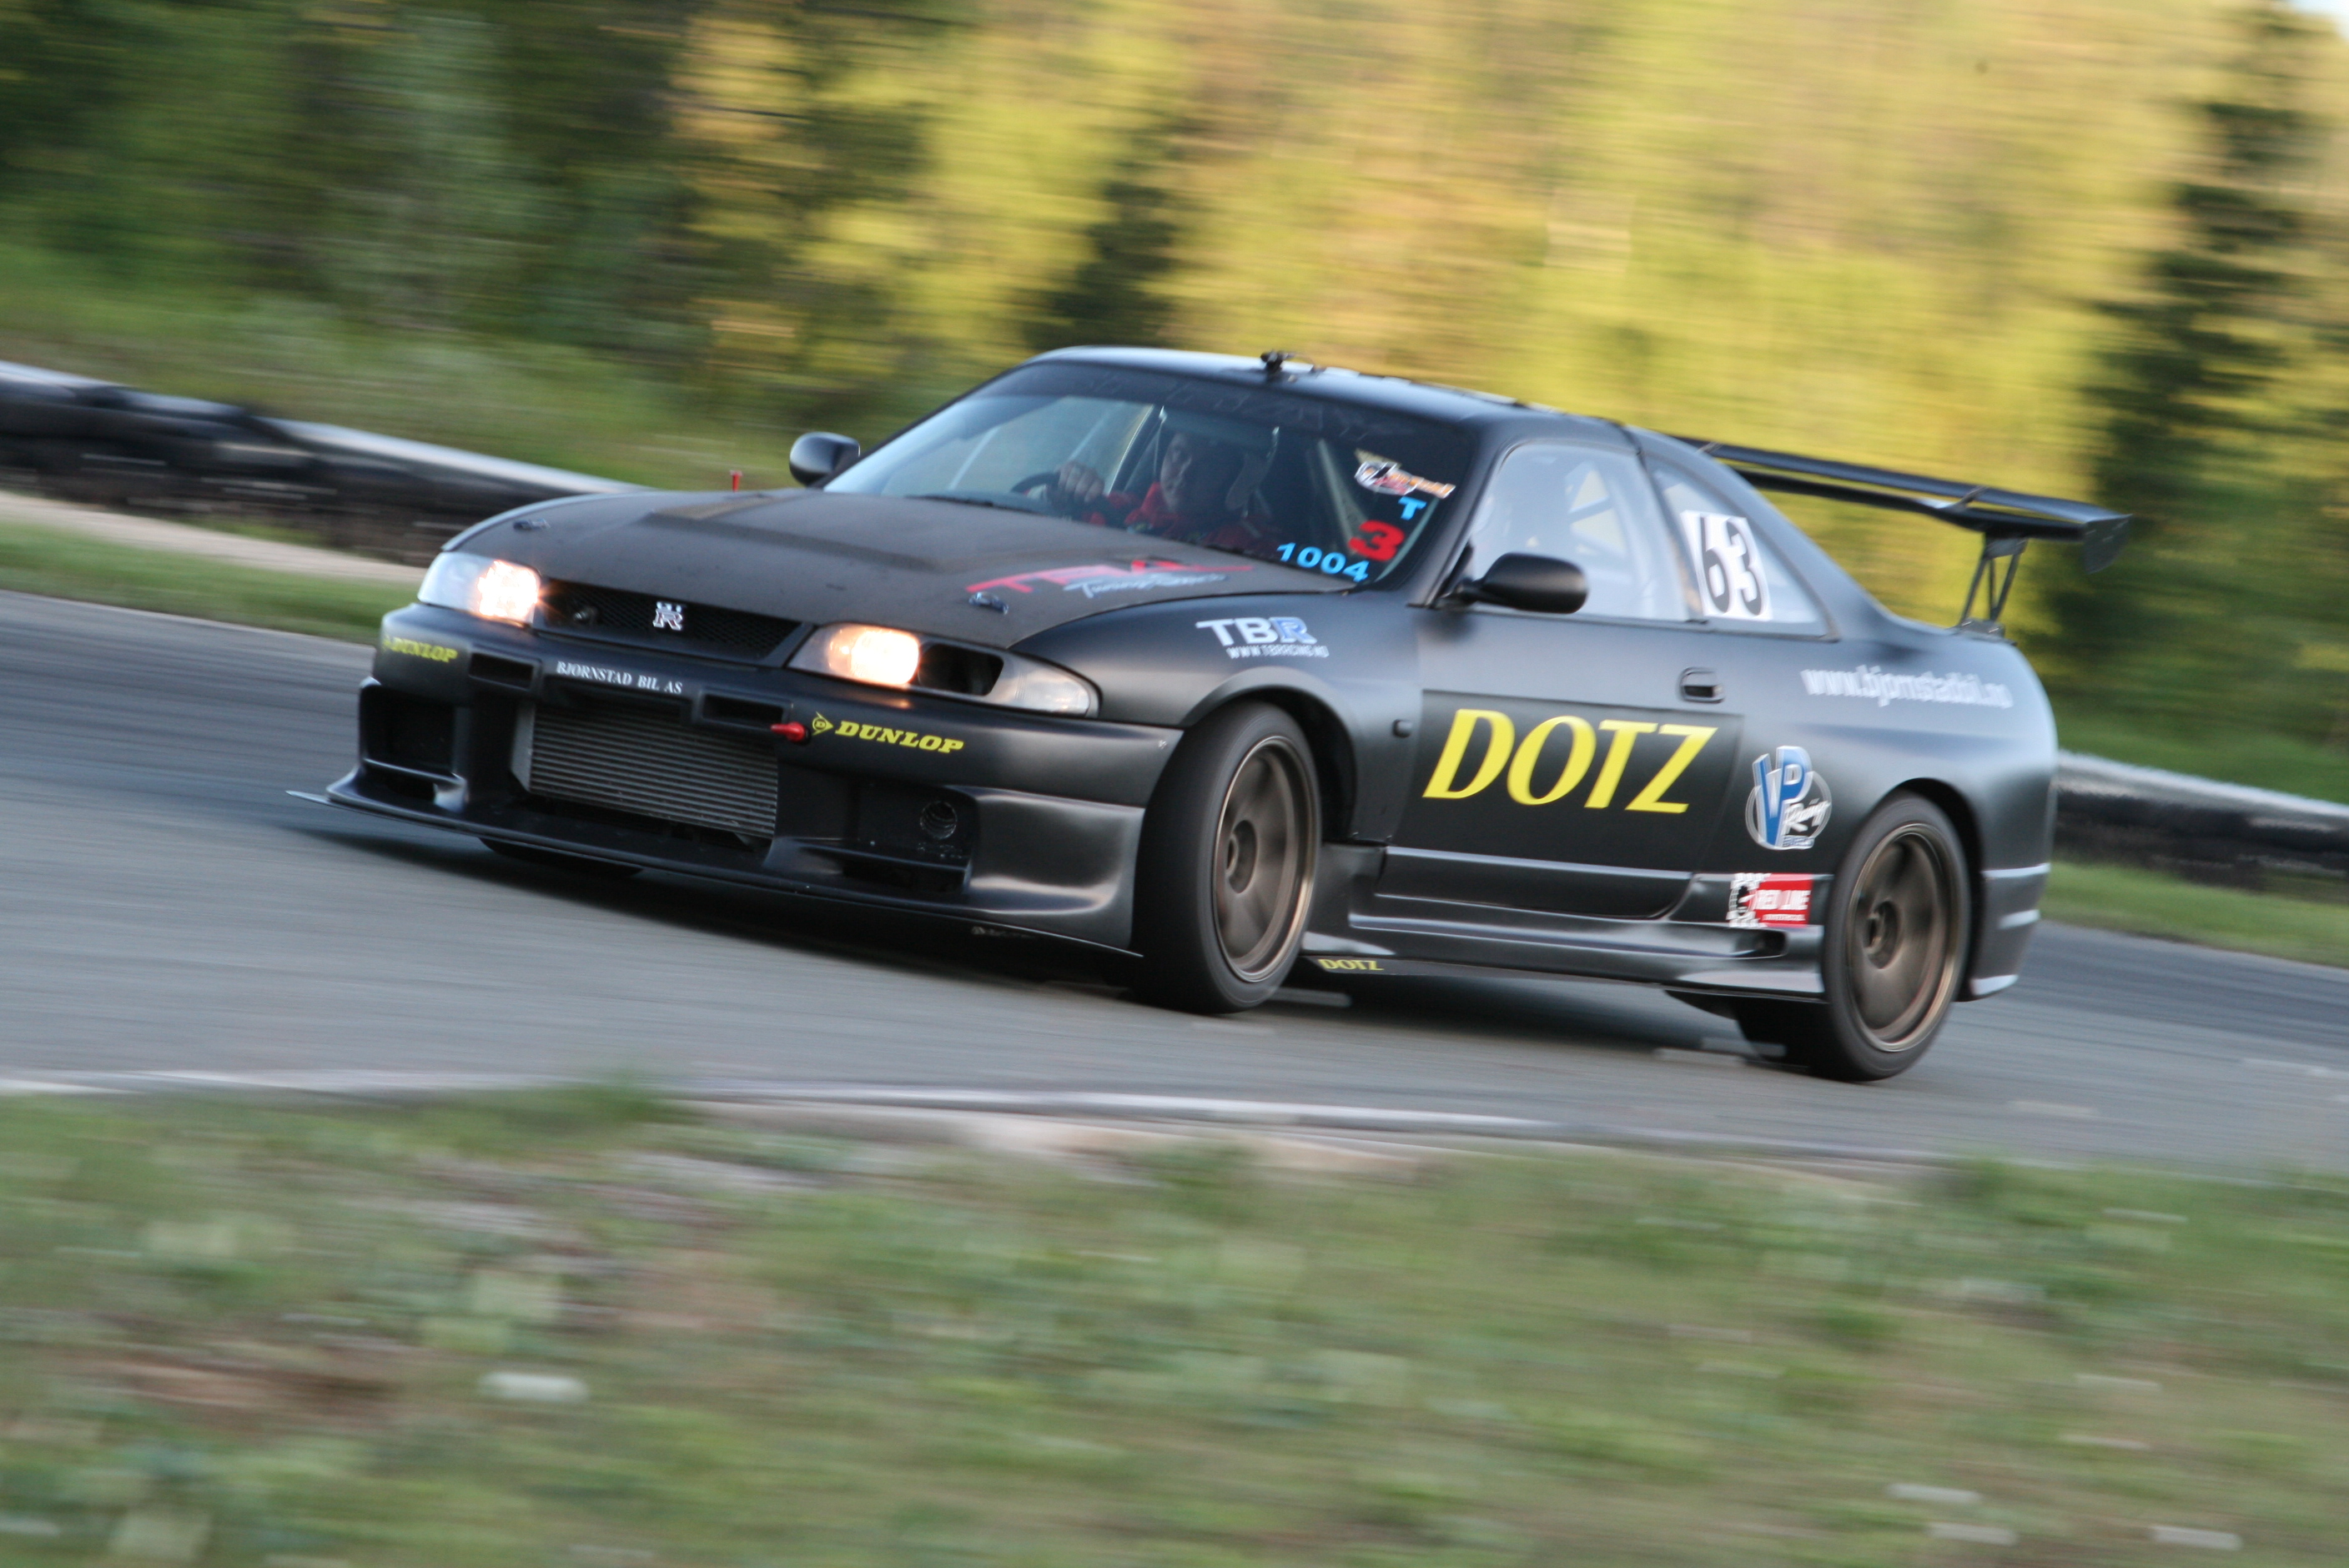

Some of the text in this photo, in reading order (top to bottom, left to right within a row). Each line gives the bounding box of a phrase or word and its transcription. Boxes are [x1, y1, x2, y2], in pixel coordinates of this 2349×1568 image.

[1398, 495, 1427, 521] T
[1347, 519, 1406, 562] 3
[1276, 542, 1370, 583] 1004
[1699, 515, 1766, 616] 63
[1195, 616, 1318, 647] TBR
[390, 636, 459, 664] DUNLOP
[636, 674, 661, 691] BIL
[663, 680, 684, 696] AS
[835, 720, 964, 754] DUNLOP
[1423, 708, 1718, 814] DOTZ
[1752, 745, 1813, 847] VP
[1318, 958, 1385, 971] DOTZ
